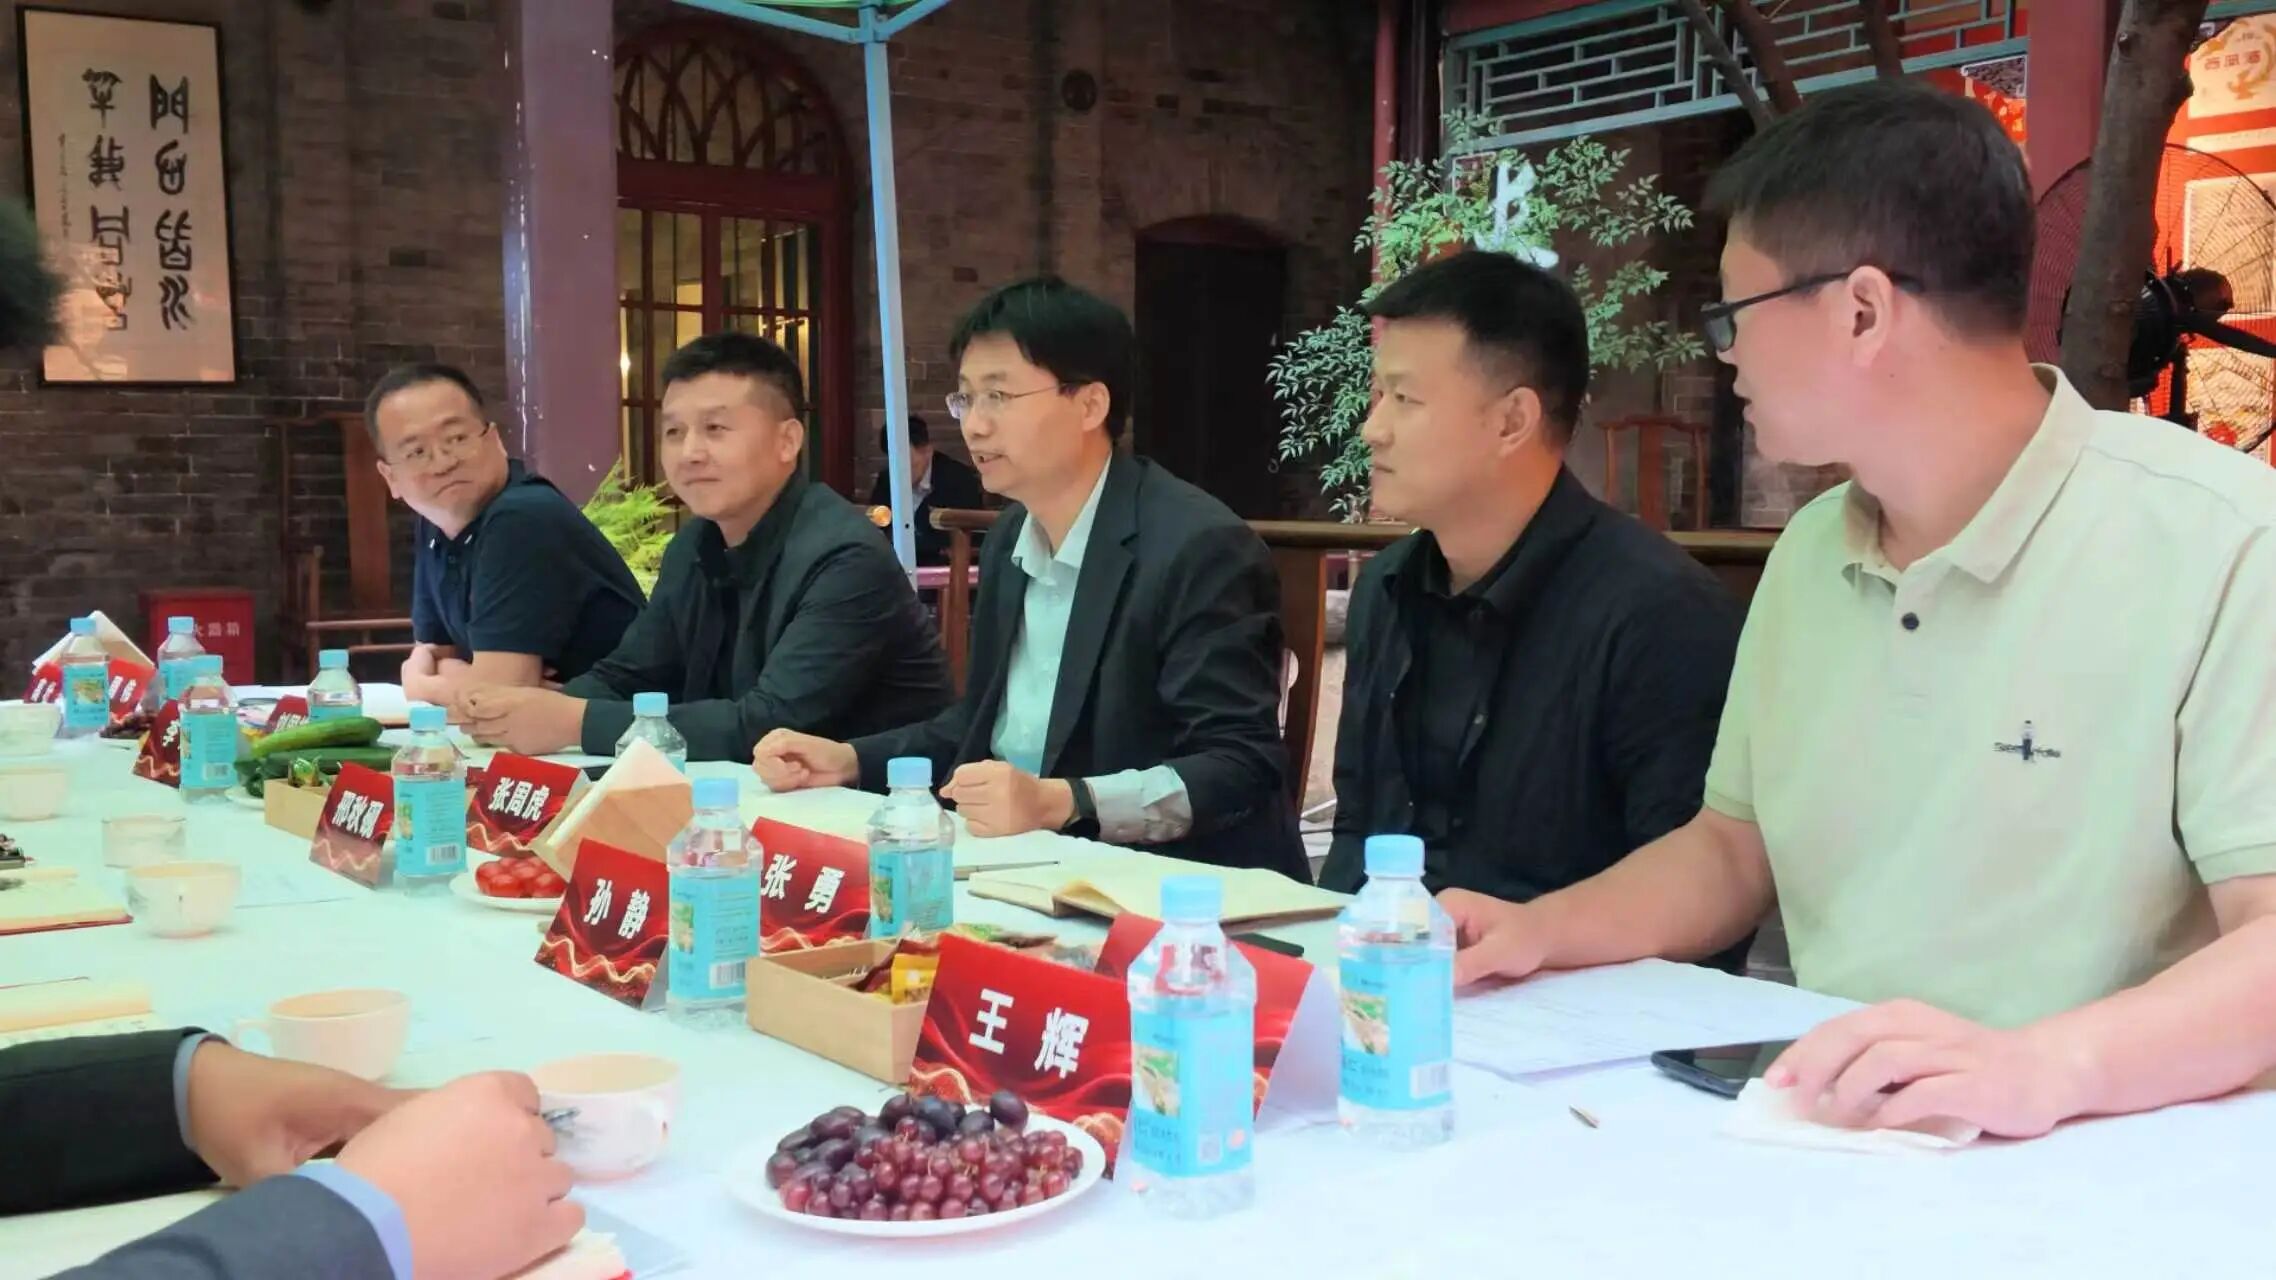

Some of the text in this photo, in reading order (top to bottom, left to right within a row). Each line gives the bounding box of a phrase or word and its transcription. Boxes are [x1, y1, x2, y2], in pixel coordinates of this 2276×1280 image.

[488, 777, 550, 821] 张周虎
[583, 878, 650, 940] 孙静
[760, 853, 845, 914] 张勇
[968, 988, 1089, 1079] 王辉
